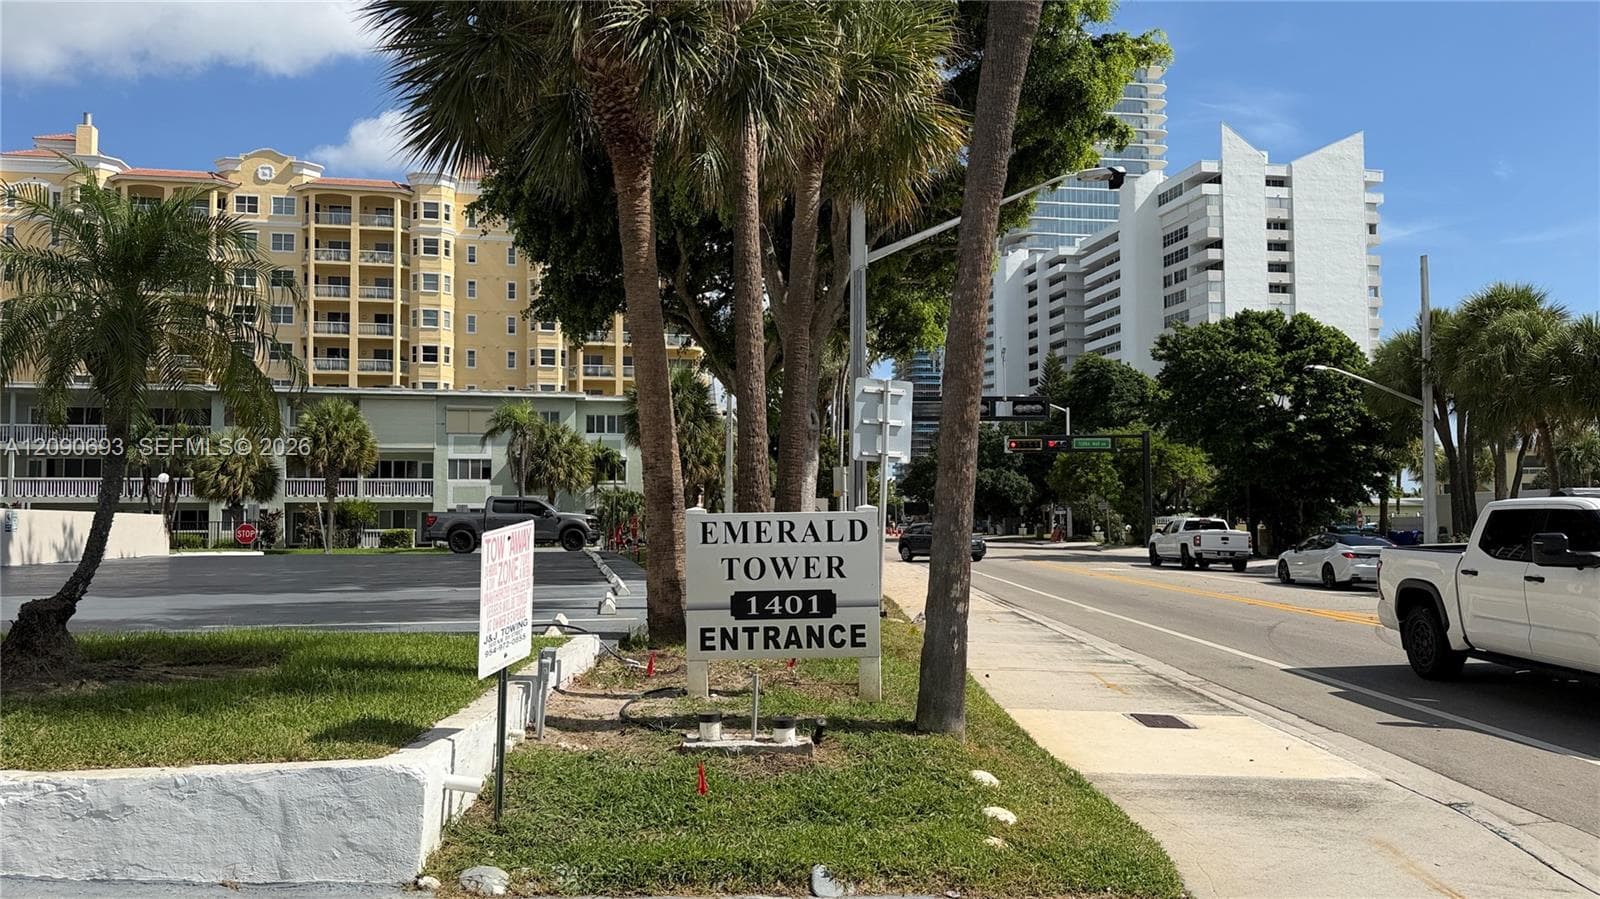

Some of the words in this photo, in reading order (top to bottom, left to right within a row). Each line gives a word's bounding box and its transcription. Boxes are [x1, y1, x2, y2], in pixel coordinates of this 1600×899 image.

[237, 529, 256, 538] STOP
[700, 519, 869, 544] EMERALD
[484, 535, 506, 563] TOW
[509, 527, 532, 555] AWAY
[498, 557, 519, 586] ZONE
[720, 555, 847, 581] TOWER
[746, 595, 821, 616] 1401
[483, 632, 498, 645] J&J
[501, 618, 528, 636] TOWING
[700, 624, 867, 651] ENTRANCE
